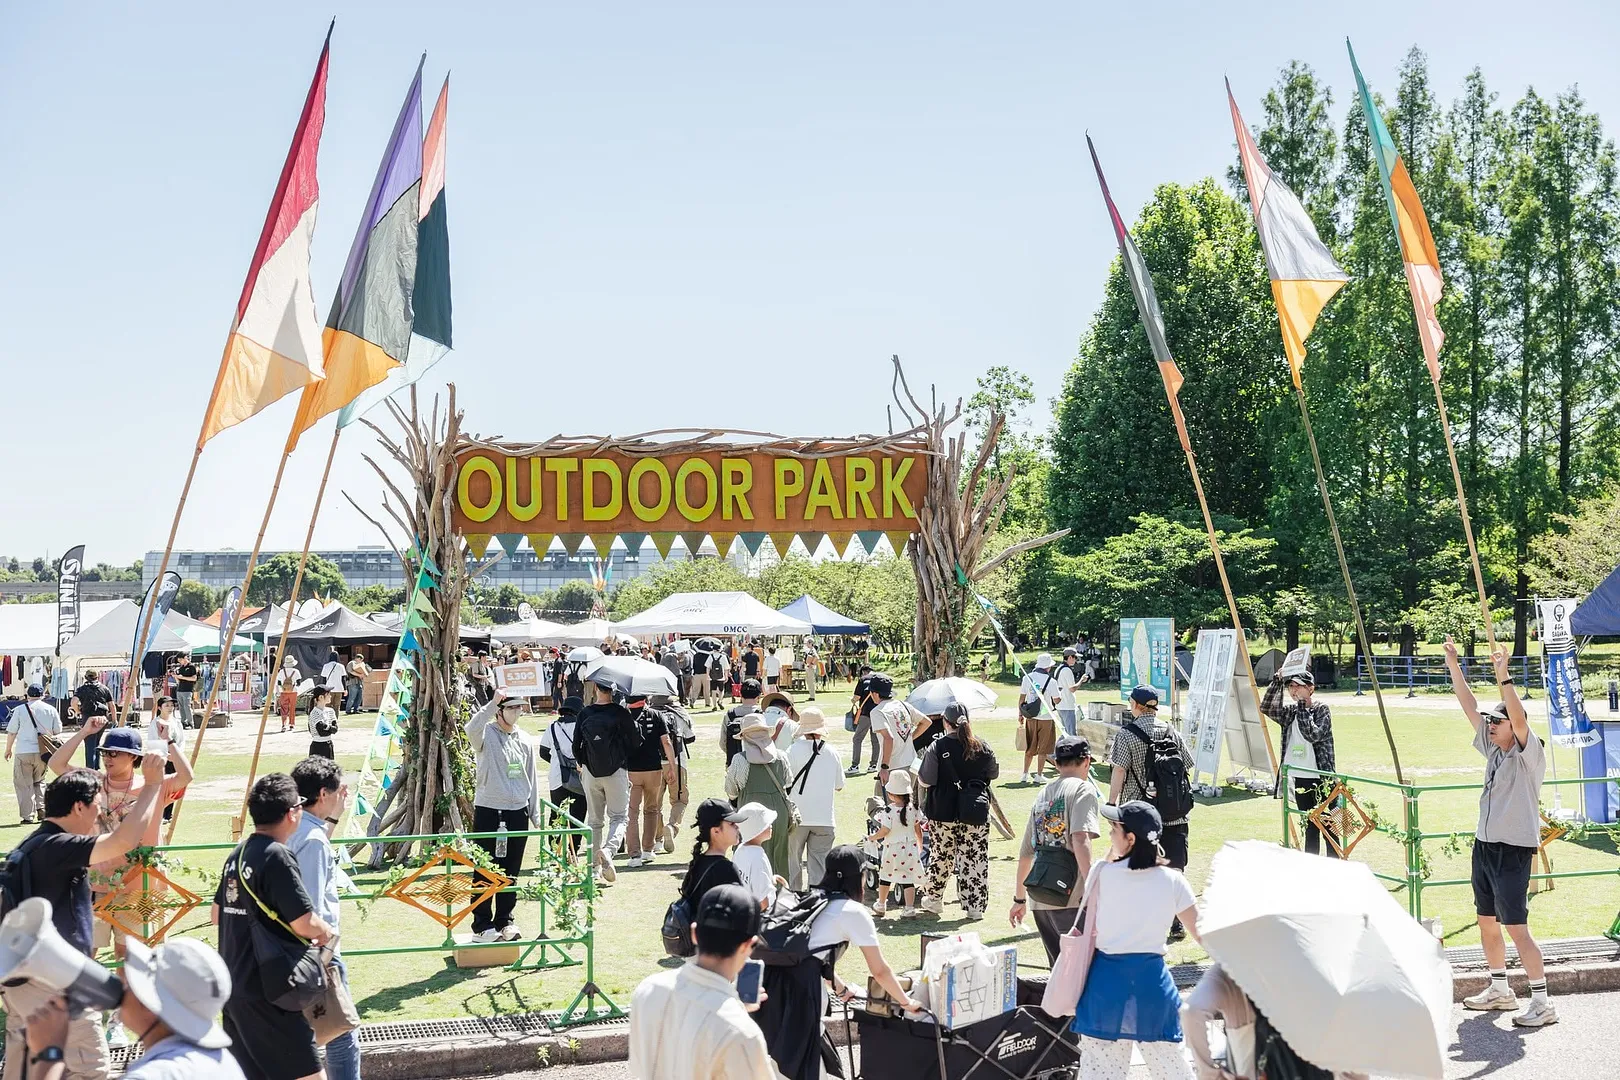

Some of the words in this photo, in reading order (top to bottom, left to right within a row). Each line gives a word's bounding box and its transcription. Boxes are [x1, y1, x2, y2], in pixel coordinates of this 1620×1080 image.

[458, 456, 754, 522] OUTDOOR
[775, 457, 916, 520] PARK
[59, 558, 81, 646] SUNLINE
[1561, 735, 1594, 745] SAGAWA
[224, 860, 253, 880] PAIS
